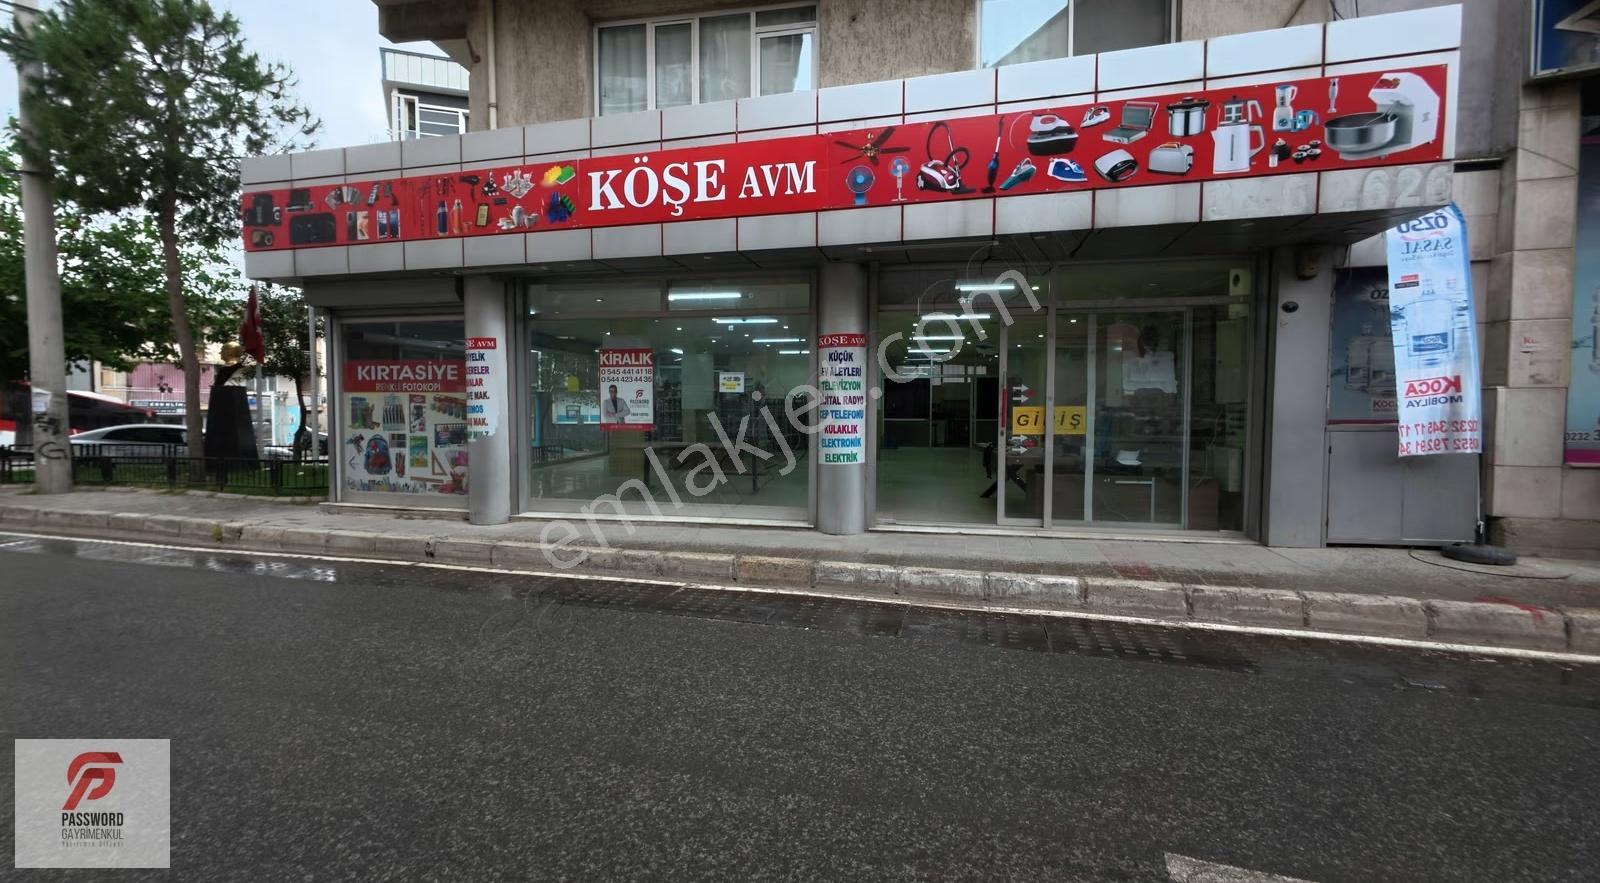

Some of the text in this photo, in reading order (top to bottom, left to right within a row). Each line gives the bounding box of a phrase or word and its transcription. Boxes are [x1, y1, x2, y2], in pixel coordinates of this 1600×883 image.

[588, 156, 817, 217] KÖŞE AVM
[600, 351, 653, 365] KİRALIK
[828, 350, 854, 364] KÜÇÜK
[357, 361, 458, 380] KIRTASİYE
[843, 395, 864, 405] RADYO
[1016, 410, 1081, 429] GİİŞ
[824, 424, 858, 434] KULAKLIK
[821, 435, 862, 448] ELEKTRONİK
[825, 450, 858, 463] ELEKTRİK
